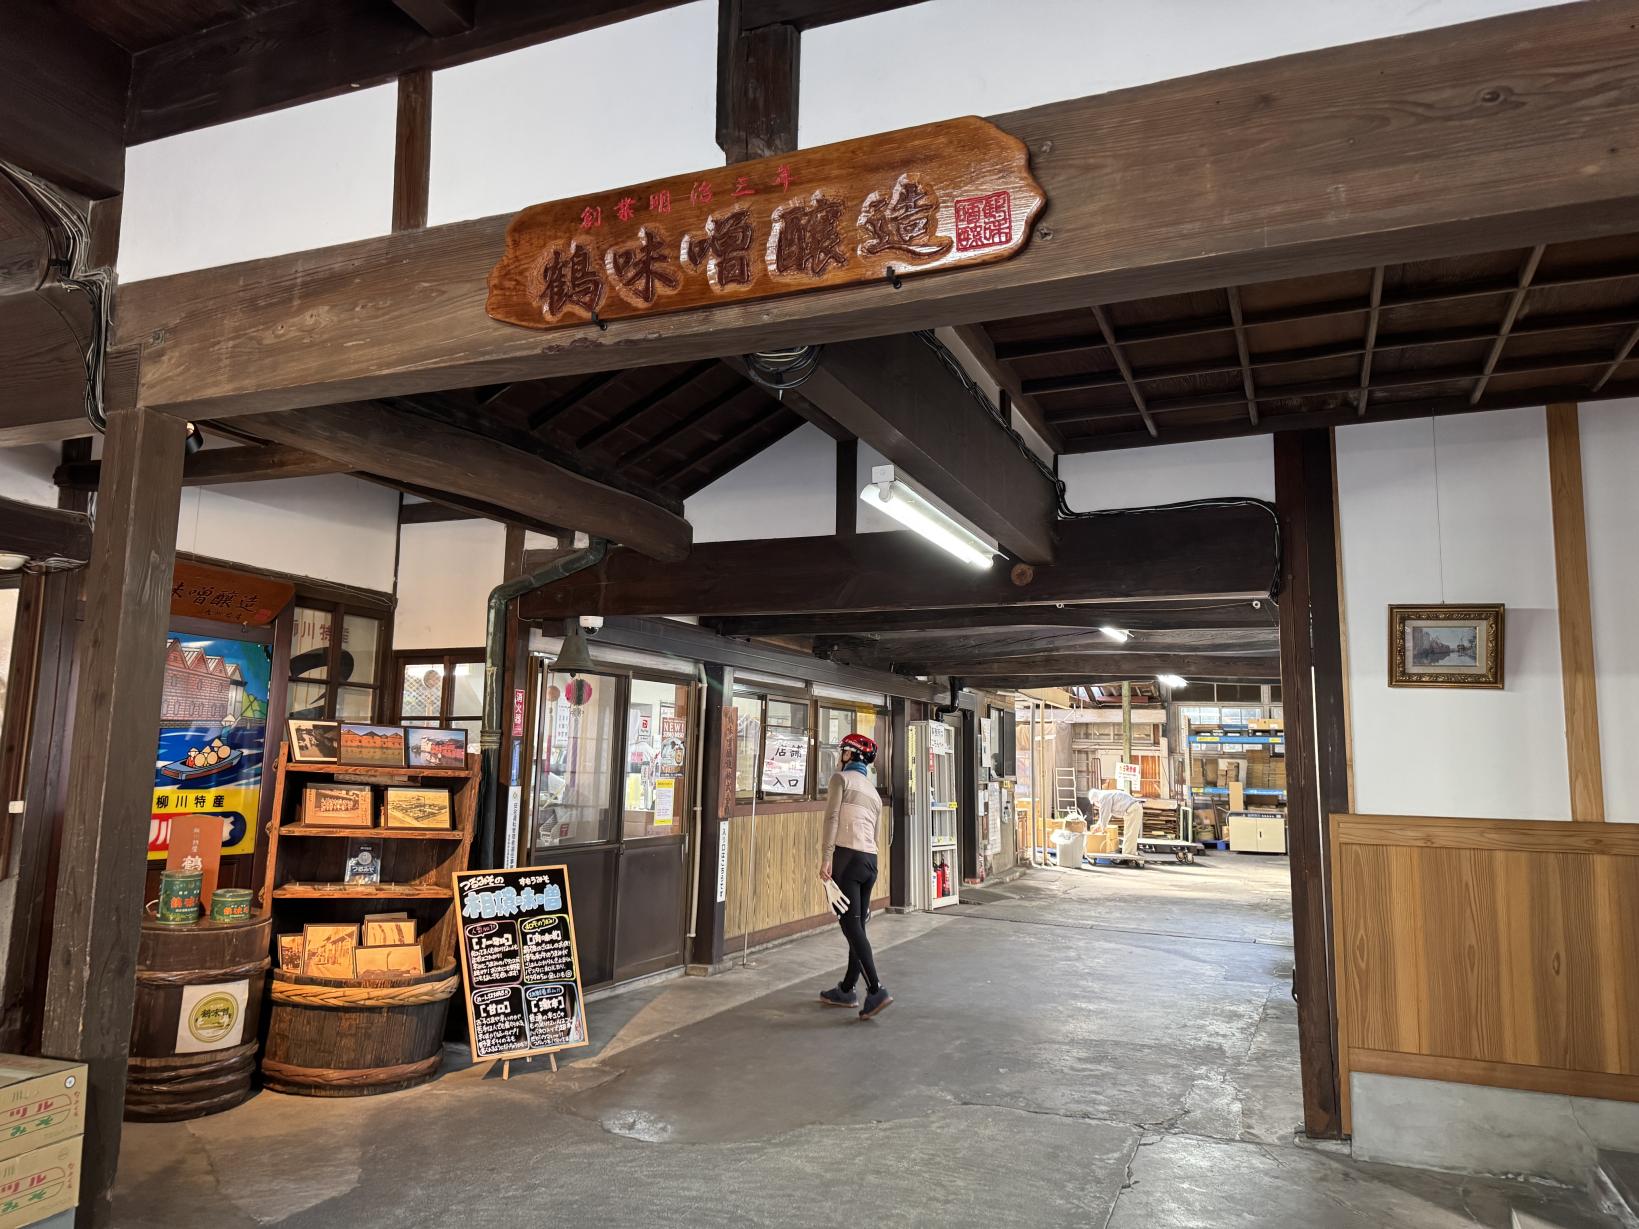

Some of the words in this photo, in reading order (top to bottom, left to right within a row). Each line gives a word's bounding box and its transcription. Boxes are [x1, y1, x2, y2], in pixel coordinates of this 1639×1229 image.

[580, 163, 798, 231] 創業明治三年
[541, 174, 953, 316] 鶴味噌醸造
[663, 721, 684, 732] NEW!
[774, 744, 804, 758] 店舗
[773, 777, 799, 788] 入口
[156, 795, 225, 808] 柳川特産
[459, 875, 505, 891] つるみその
[518, 874, 550, 887] すもうみそ
